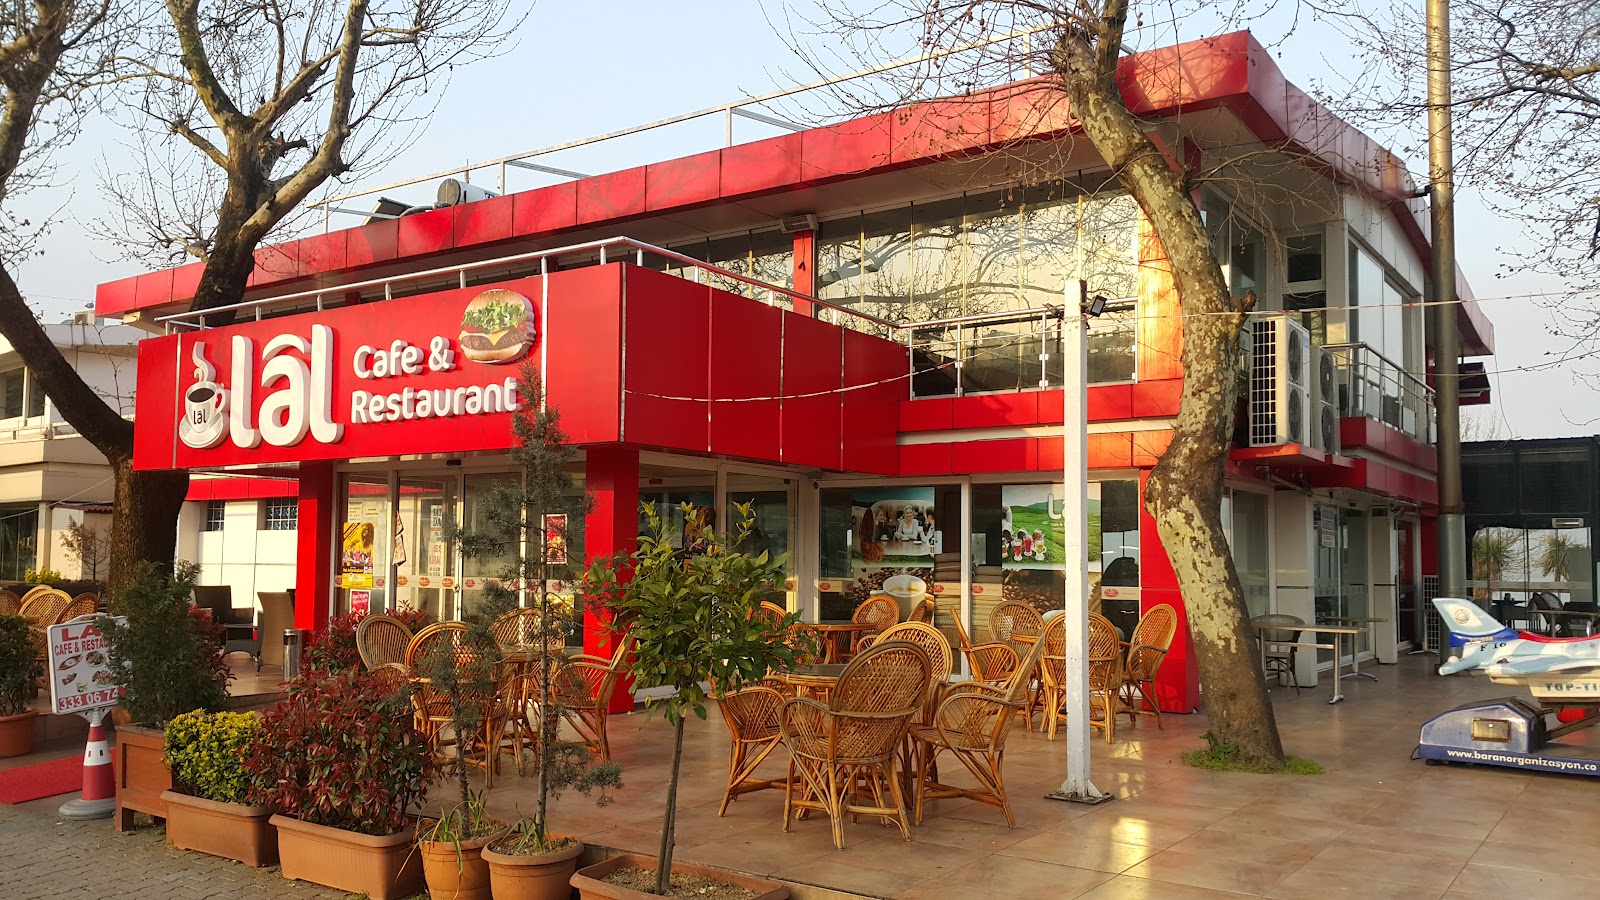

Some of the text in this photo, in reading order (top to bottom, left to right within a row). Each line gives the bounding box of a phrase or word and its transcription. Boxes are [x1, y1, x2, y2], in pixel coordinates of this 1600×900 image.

[352, 336, 456, 379] Cafe &
[229, 323, 345, 449] lâl
[350, 375, 520, 424] Restaurant
[61, 624, 102, 641] LA
[54, 637, 109, 656] CAFE & RESTAU
[1480, 644, 1487, 652] F
[1544, 682, 1600, 692] TOP-TI
[60, 688, 118, 710] 333 06 74
[1447, 749, 1597, 772] www.baranorganizasyon.co
